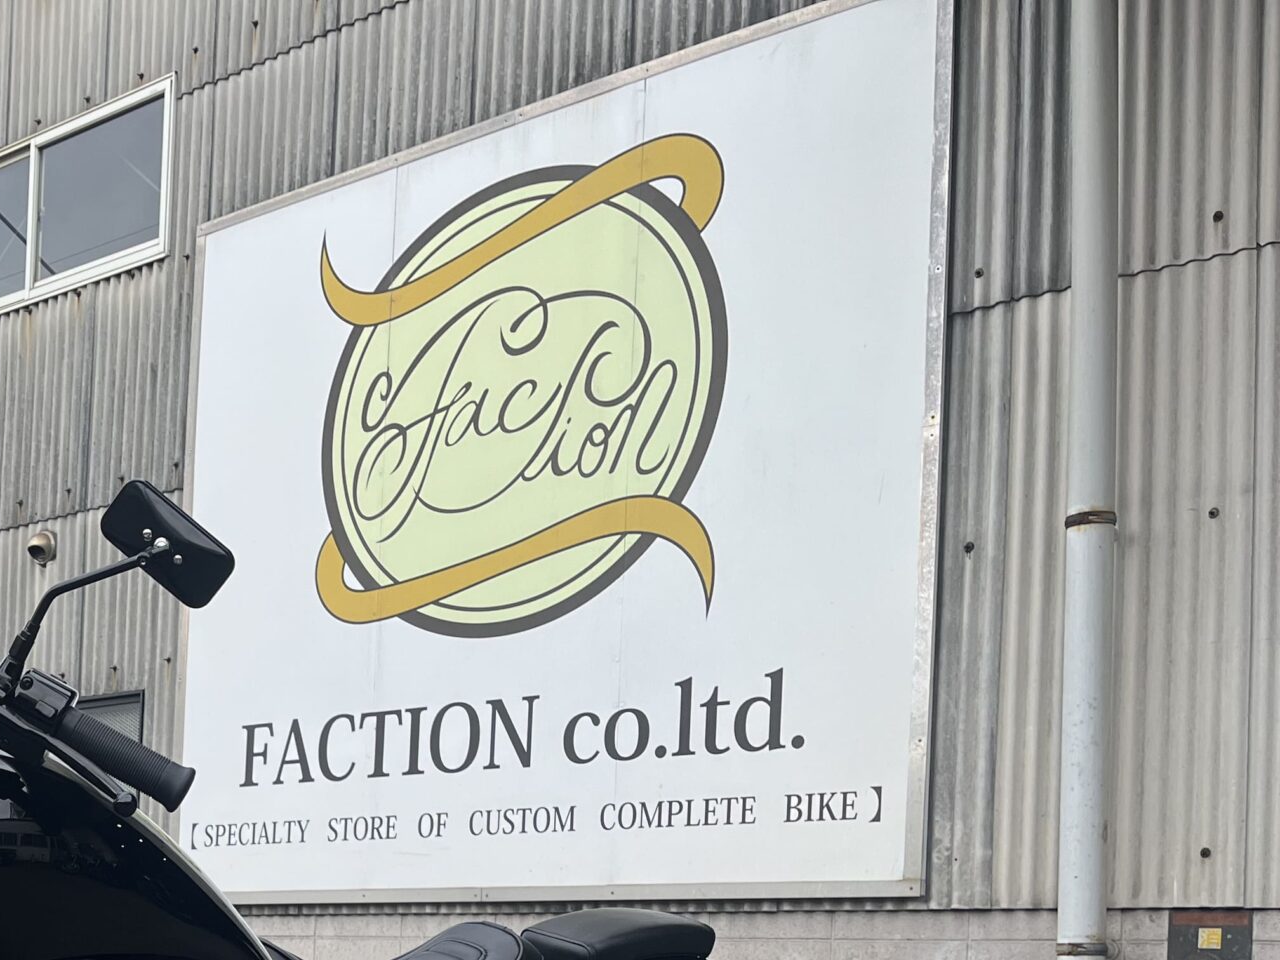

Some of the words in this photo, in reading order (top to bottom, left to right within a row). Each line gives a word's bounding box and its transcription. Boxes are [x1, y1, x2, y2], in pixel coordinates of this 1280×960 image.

[238, 694, 540, 788] FACTION
[562, 667, 806, 766] co.ltd.
[326, 814, 398, 843] STORE
[417, 812, 449, 839] OF
[468, 805, 577, 837] CUSTOM
[599, 795, 757, 832] COMPLETE
